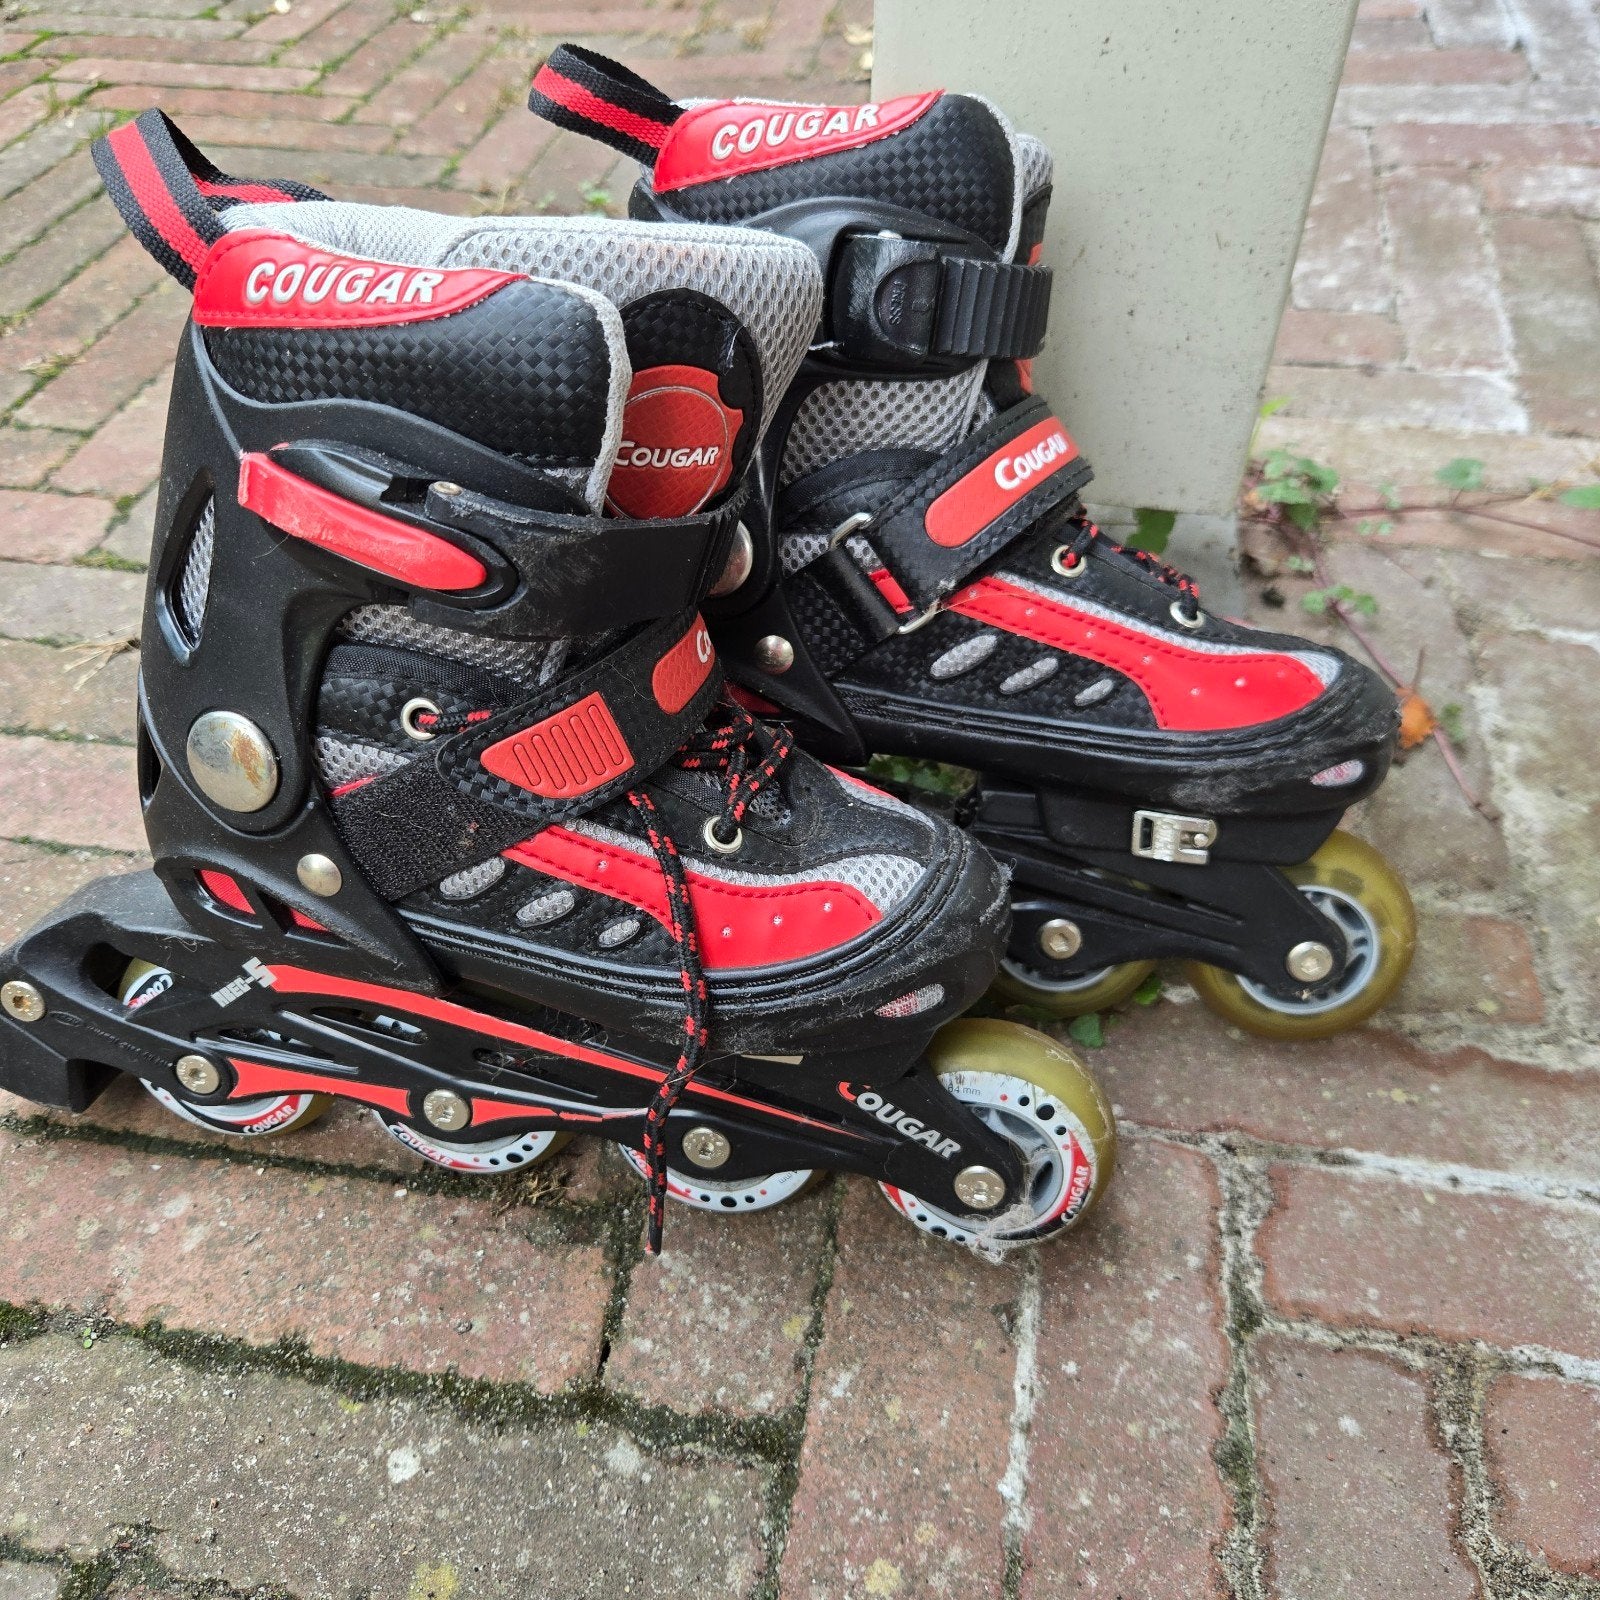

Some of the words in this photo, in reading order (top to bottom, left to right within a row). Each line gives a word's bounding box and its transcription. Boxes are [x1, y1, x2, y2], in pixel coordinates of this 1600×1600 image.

[711, 103, 880, 160] COUGAR
[246, 261, 445, 304] COUGAR
[613, 440, 719, 468] COUGAR
[242, 1104, 296, 1134] COUGAR
[837, 1081, 961, 1159] COUGAR
[388, 1124, 455, 1167] COUGAR
[1060, 1165, 1090, 1223] COUGAR
